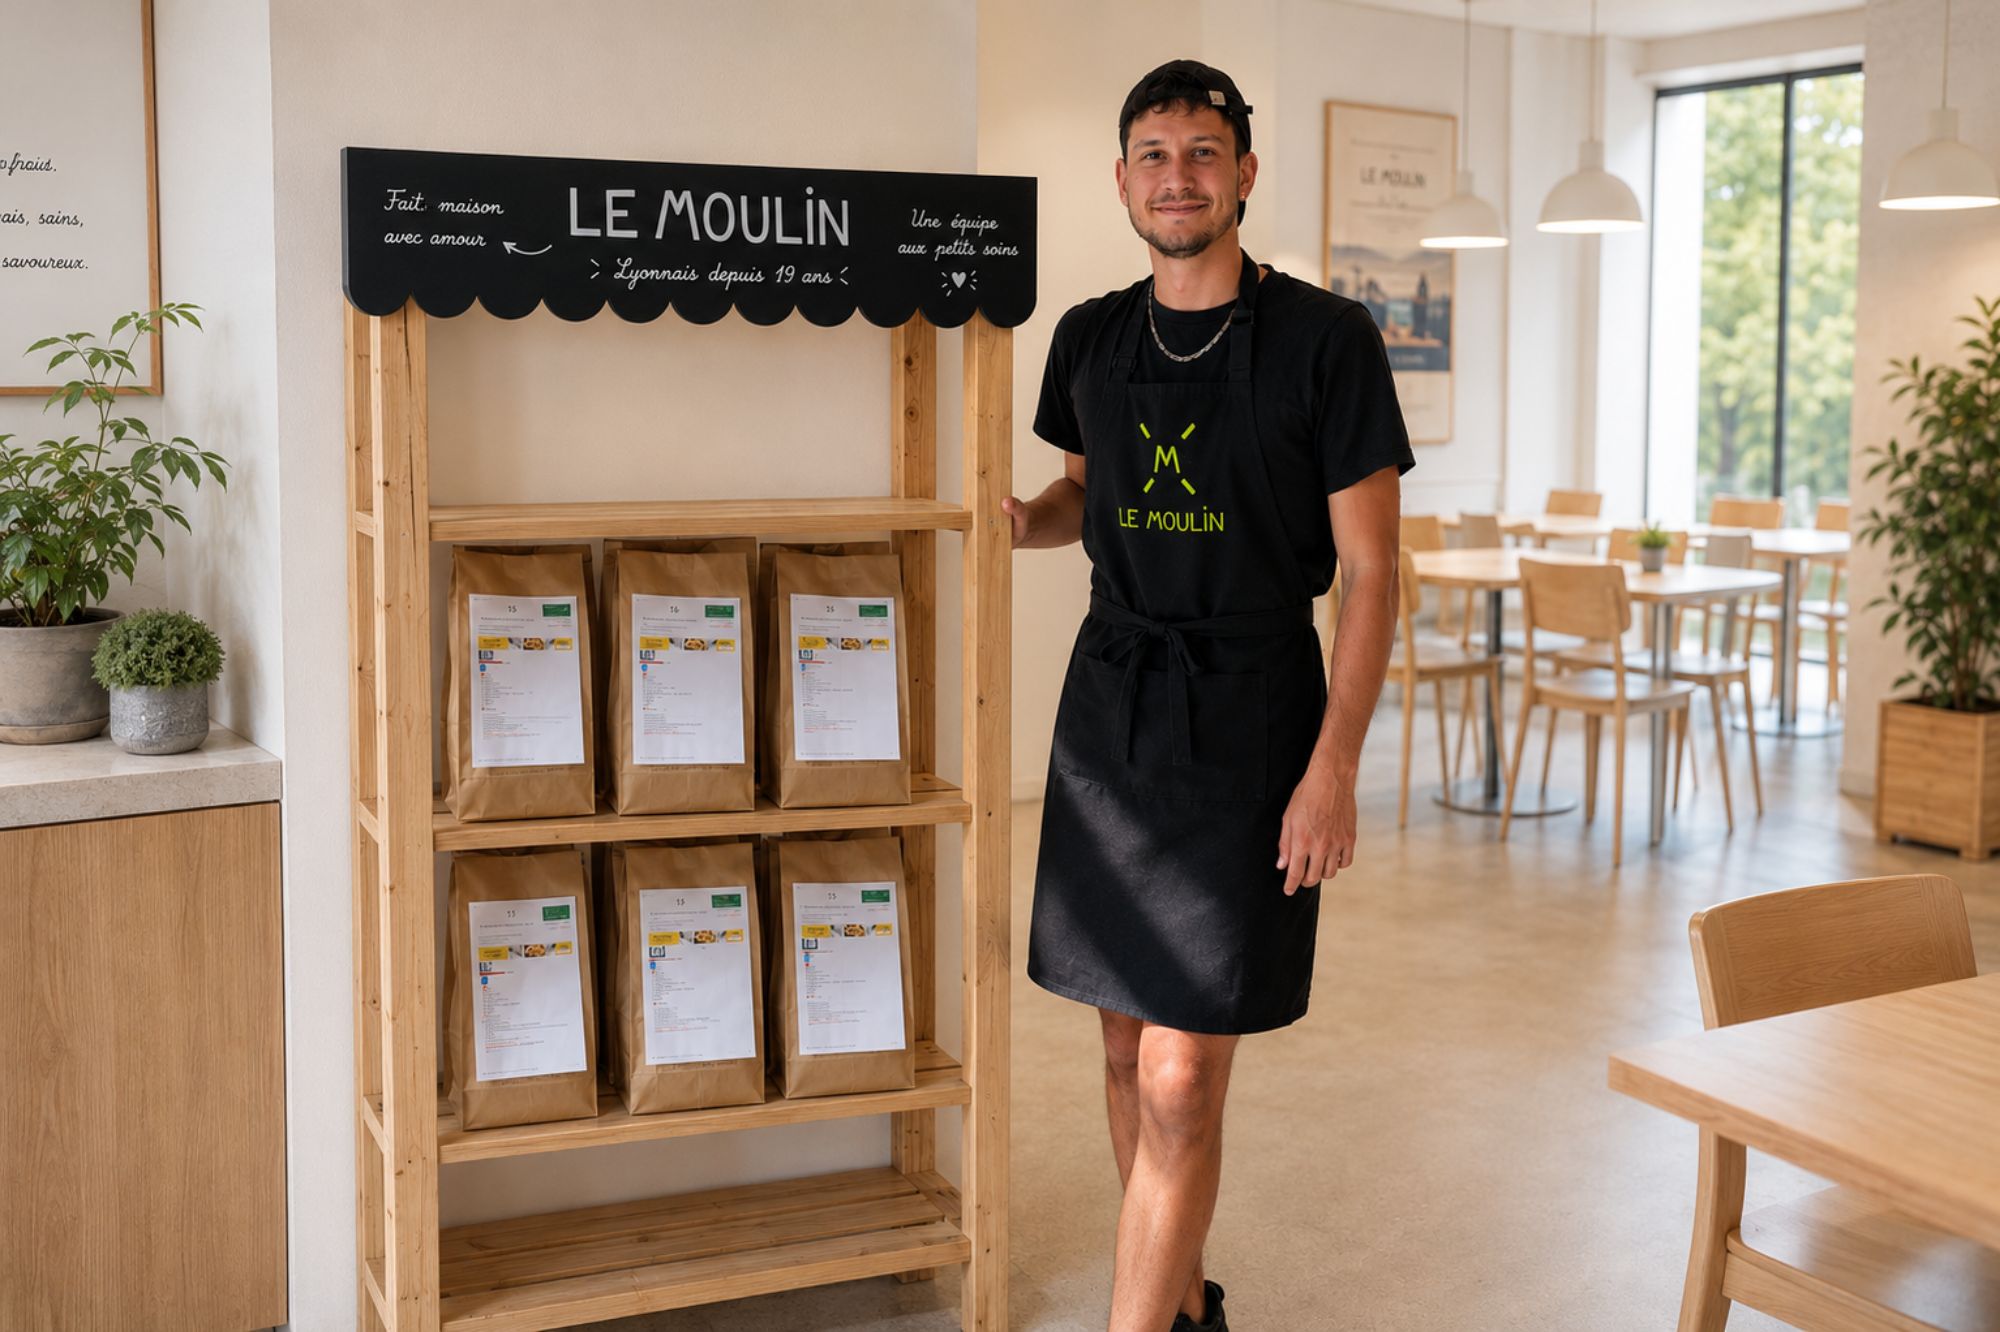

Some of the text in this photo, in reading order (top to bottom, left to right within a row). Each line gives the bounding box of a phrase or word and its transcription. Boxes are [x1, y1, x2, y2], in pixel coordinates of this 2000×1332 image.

[438, 198, 504, 214] maison
[570, 187, 638, 238] LE
[0, 208, 83, 228] ais, sains,
[911, 208, 999, 237] Une équipe
[384, 232, 486, 246] avec amour
[898, 239, 1019, 261] aux petits soins
[2, 257, 88, 269] savoureux.
[614, 257, 833, 291] Lyonnais depuis 19 ans
[1154, 445, 1180, 474] M
[1118, 507, 1139, 528] LE
